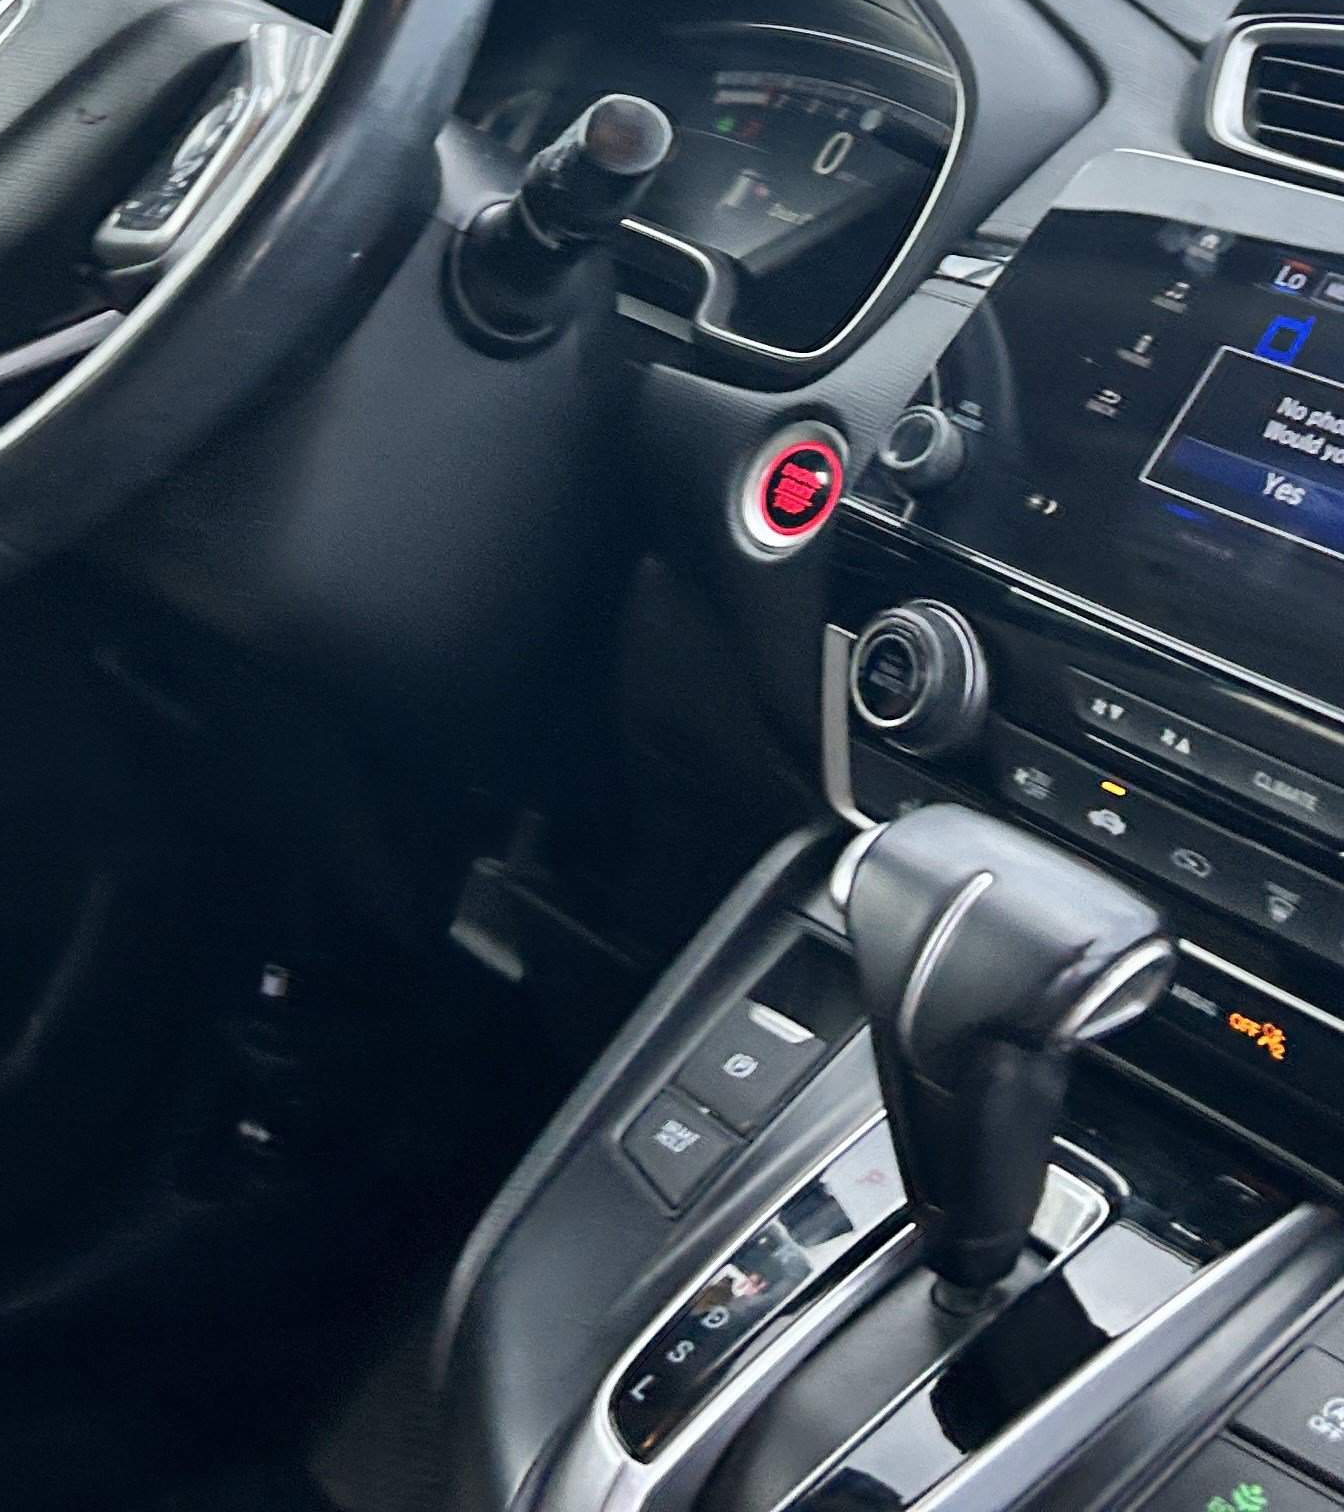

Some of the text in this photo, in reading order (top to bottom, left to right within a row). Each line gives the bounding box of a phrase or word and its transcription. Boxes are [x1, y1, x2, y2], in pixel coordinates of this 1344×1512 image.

[813, 131, 854, 175] 0
[1277, 396, 1308, 421] No
[1263, 420, 1327, 455] Would
[1261, 471, 1307, 506] Yes
